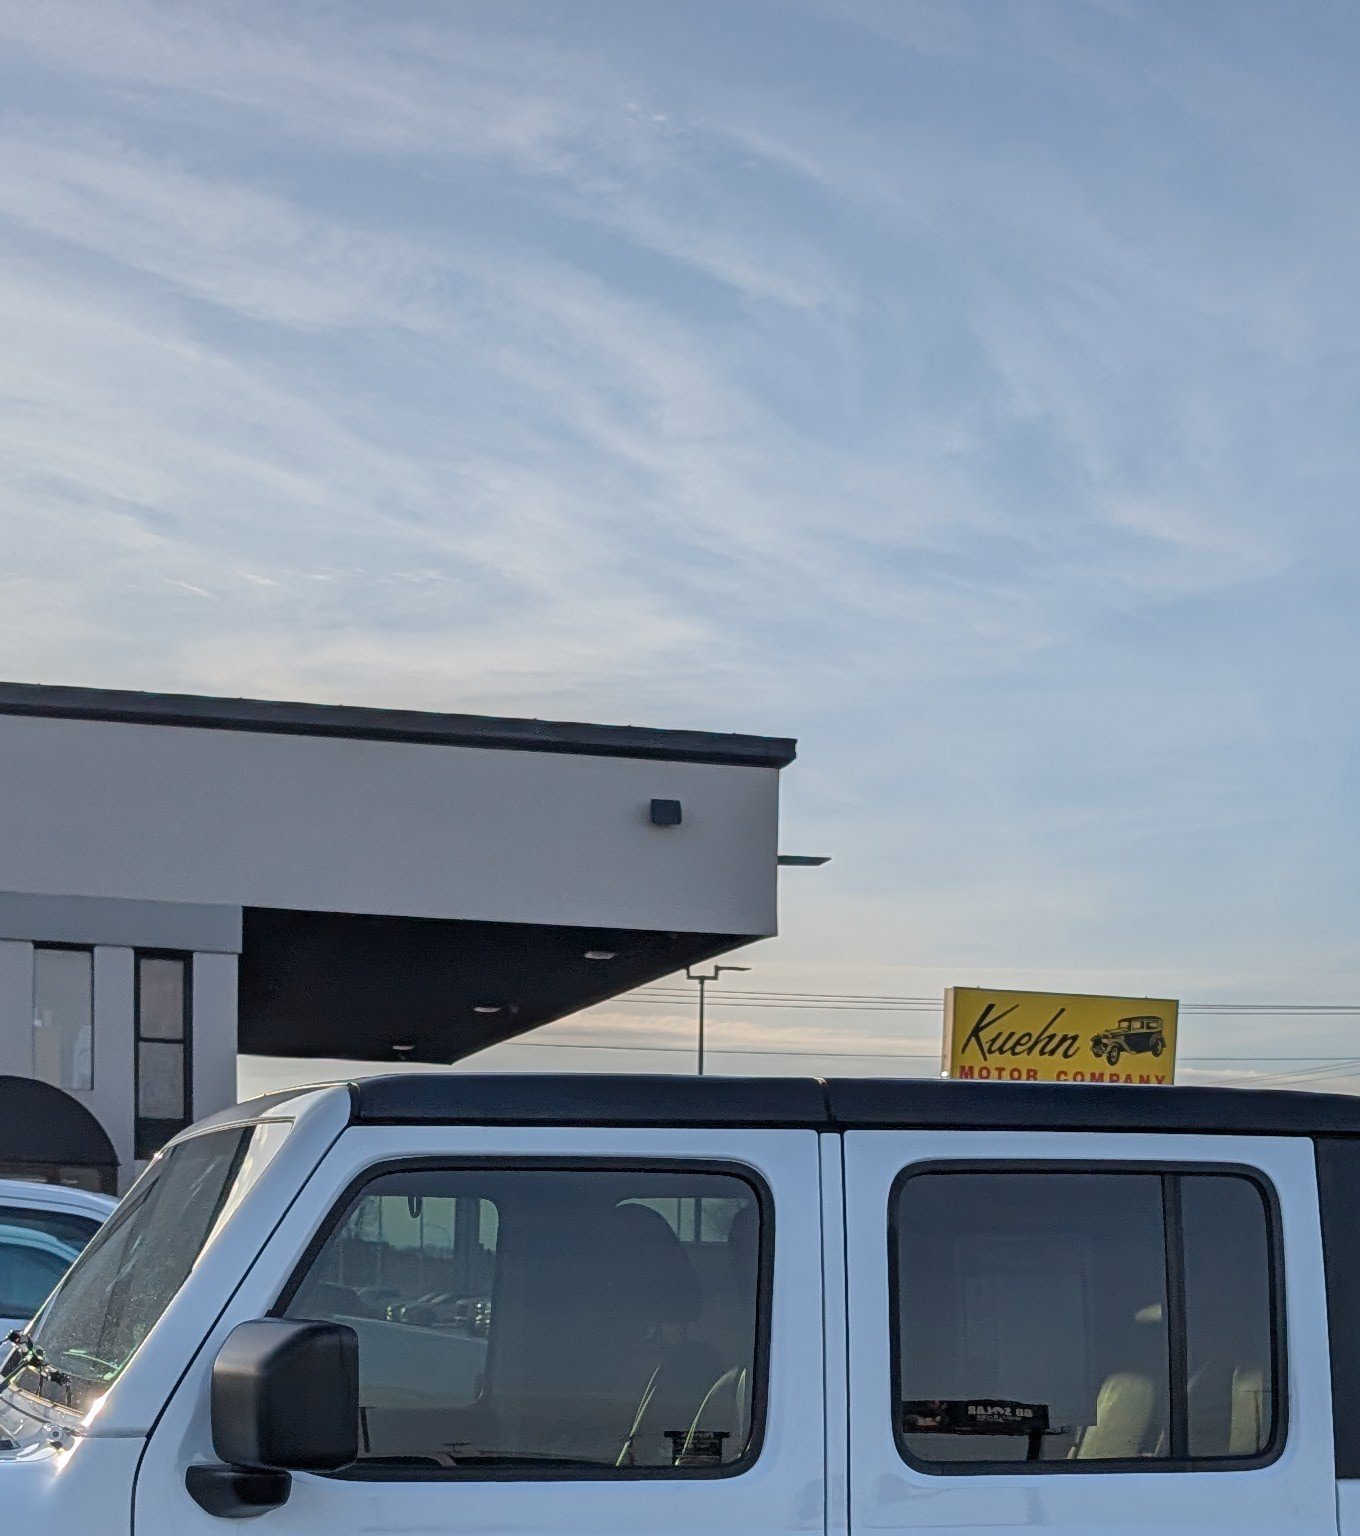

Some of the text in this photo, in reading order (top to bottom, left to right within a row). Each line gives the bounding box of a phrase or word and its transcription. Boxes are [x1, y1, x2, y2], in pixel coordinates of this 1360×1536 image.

[961, 1003, 1080, 1062] Kuehn
[959, 1065, 1166, 1085] MOTOR COMPANY
